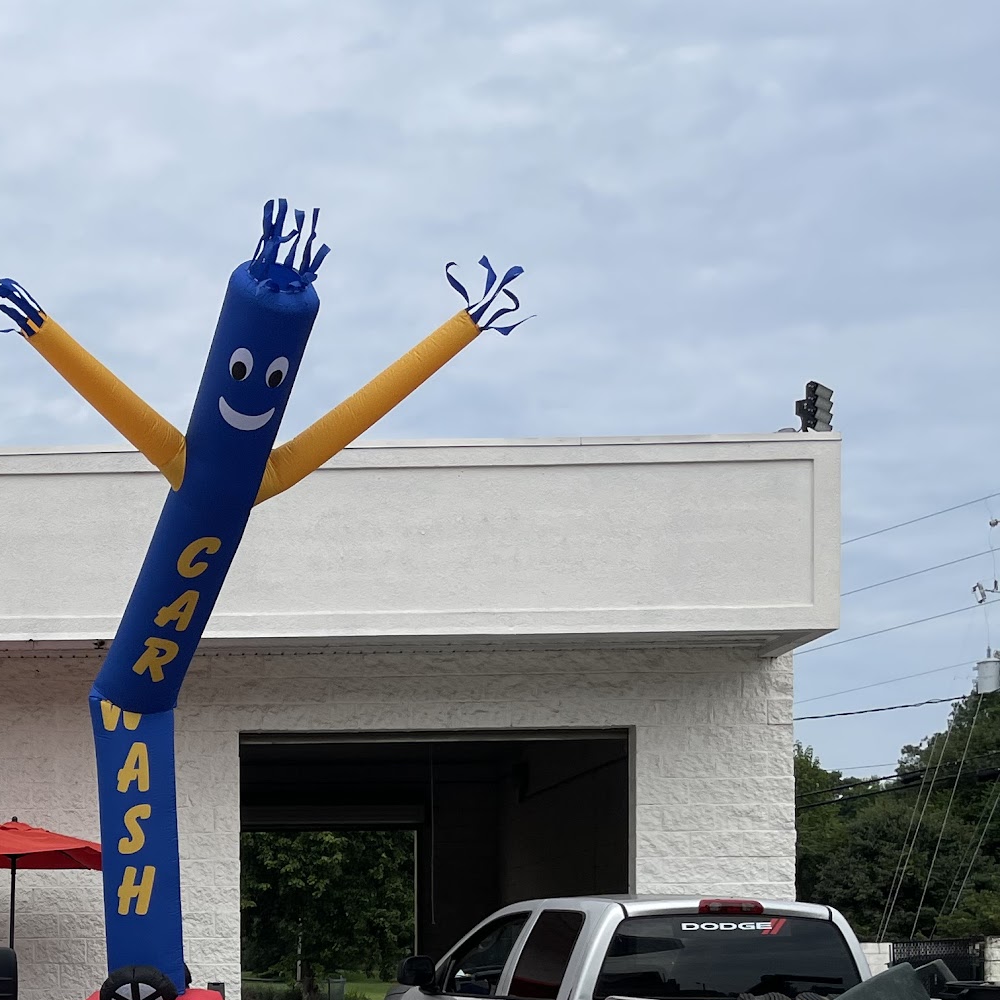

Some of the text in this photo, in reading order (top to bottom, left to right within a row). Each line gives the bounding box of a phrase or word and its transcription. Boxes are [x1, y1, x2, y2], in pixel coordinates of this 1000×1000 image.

[132, 536, 222, 683] CAR
[100, 699, 157, 916] WASH
[681, 922, 773, 931] DODGE
